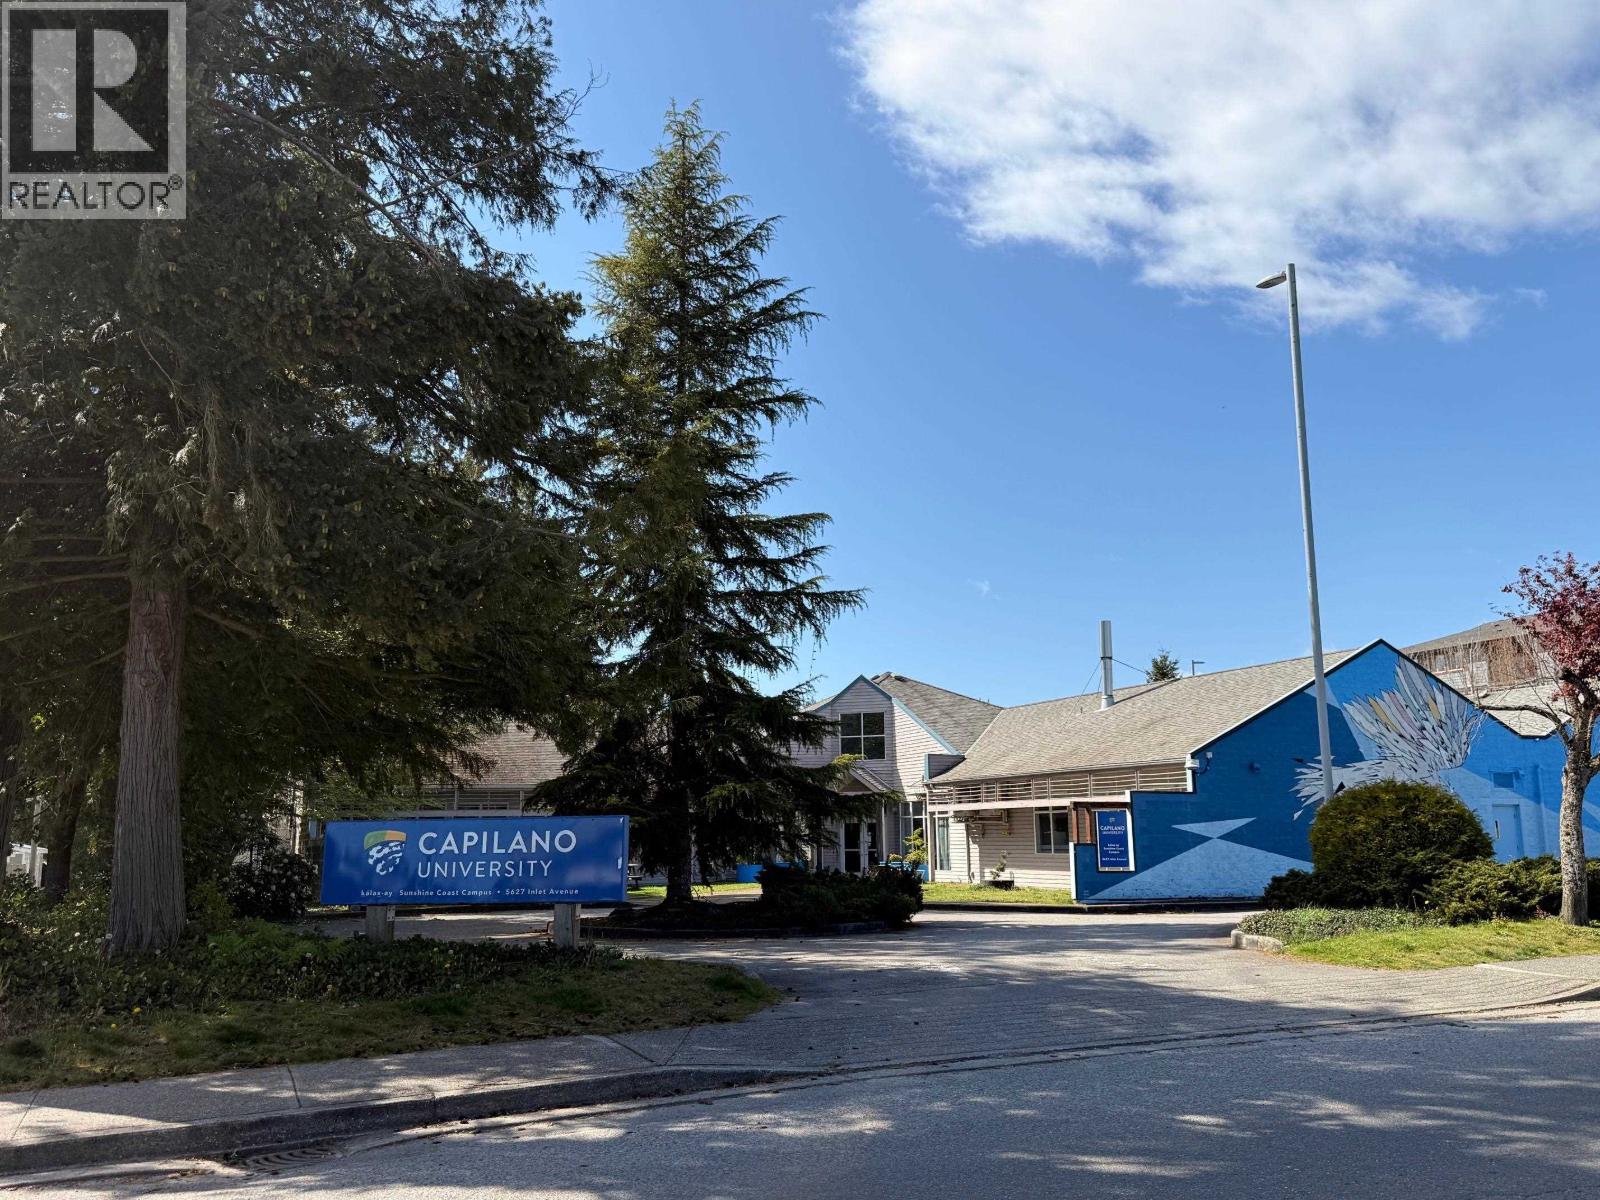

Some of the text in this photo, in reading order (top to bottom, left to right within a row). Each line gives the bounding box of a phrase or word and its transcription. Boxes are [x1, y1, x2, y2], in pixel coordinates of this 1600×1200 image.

[418, 829, 577, 854] CAPILANO
[417, 859, 553, 879] UNIVERSITY
[461, 888, 492, 897] Campus
